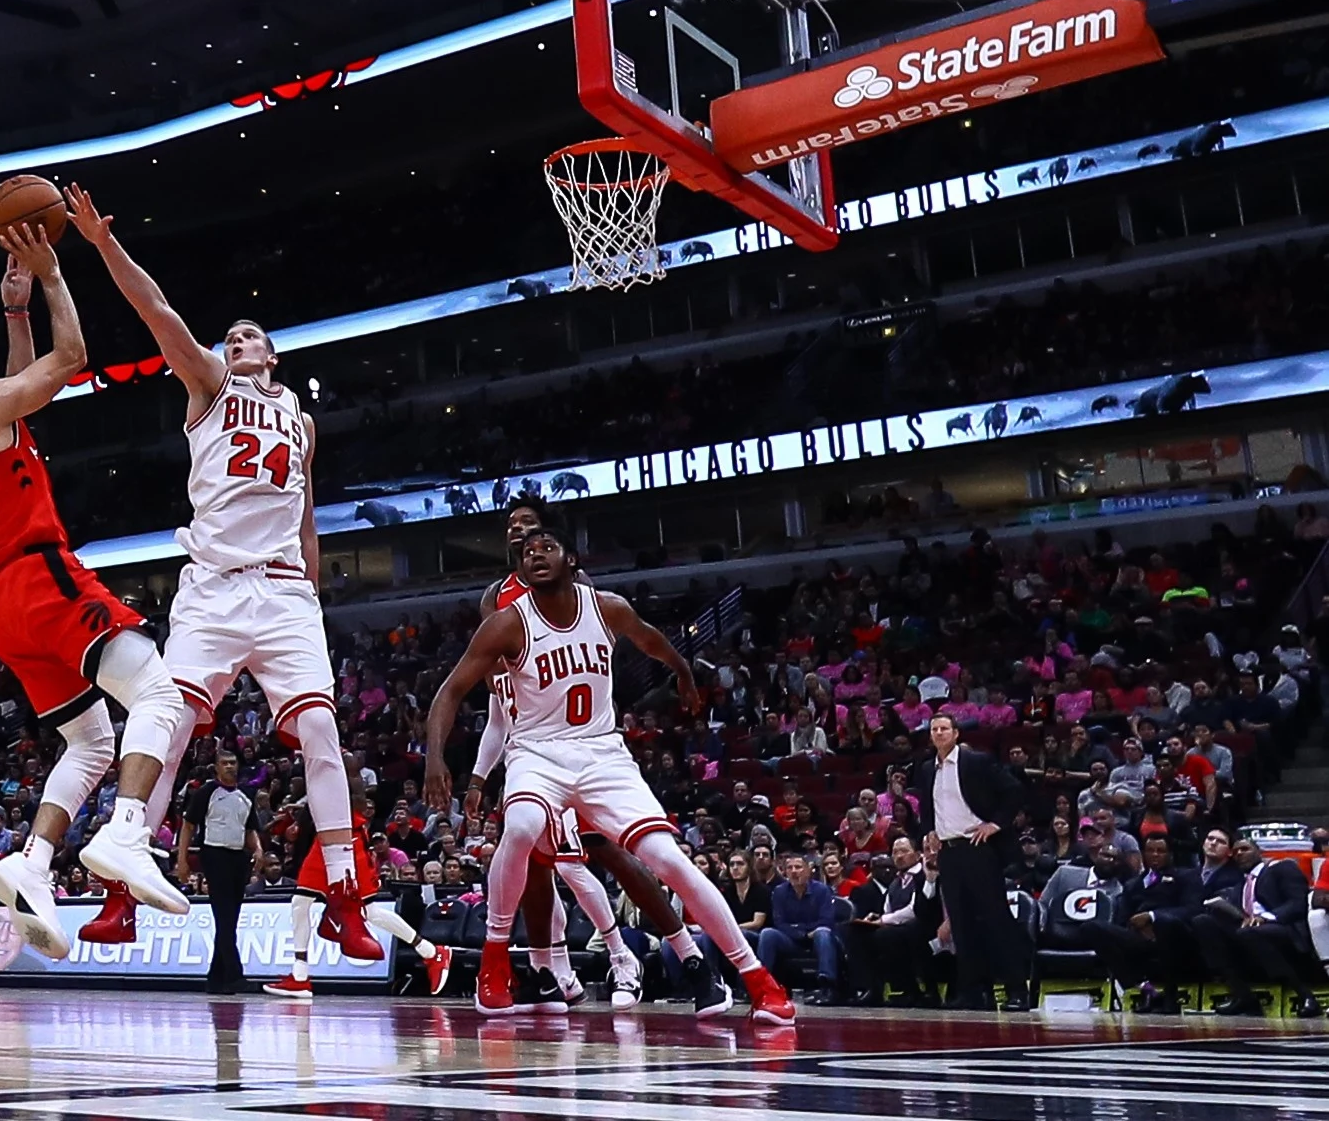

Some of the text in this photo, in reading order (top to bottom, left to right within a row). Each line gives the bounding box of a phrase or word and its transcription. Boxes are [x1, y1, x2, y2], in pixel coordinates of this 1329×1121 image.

[896, 170, 1002, 220] BULLS
[221, 396, 304, 447] BULLS
[226, 432, 292, 491] 24
[615, 412, 927, 492] CHICAGO BULLS
[534, 642, 610, 691] BULLS
[565, 682, 594, 727] 0
